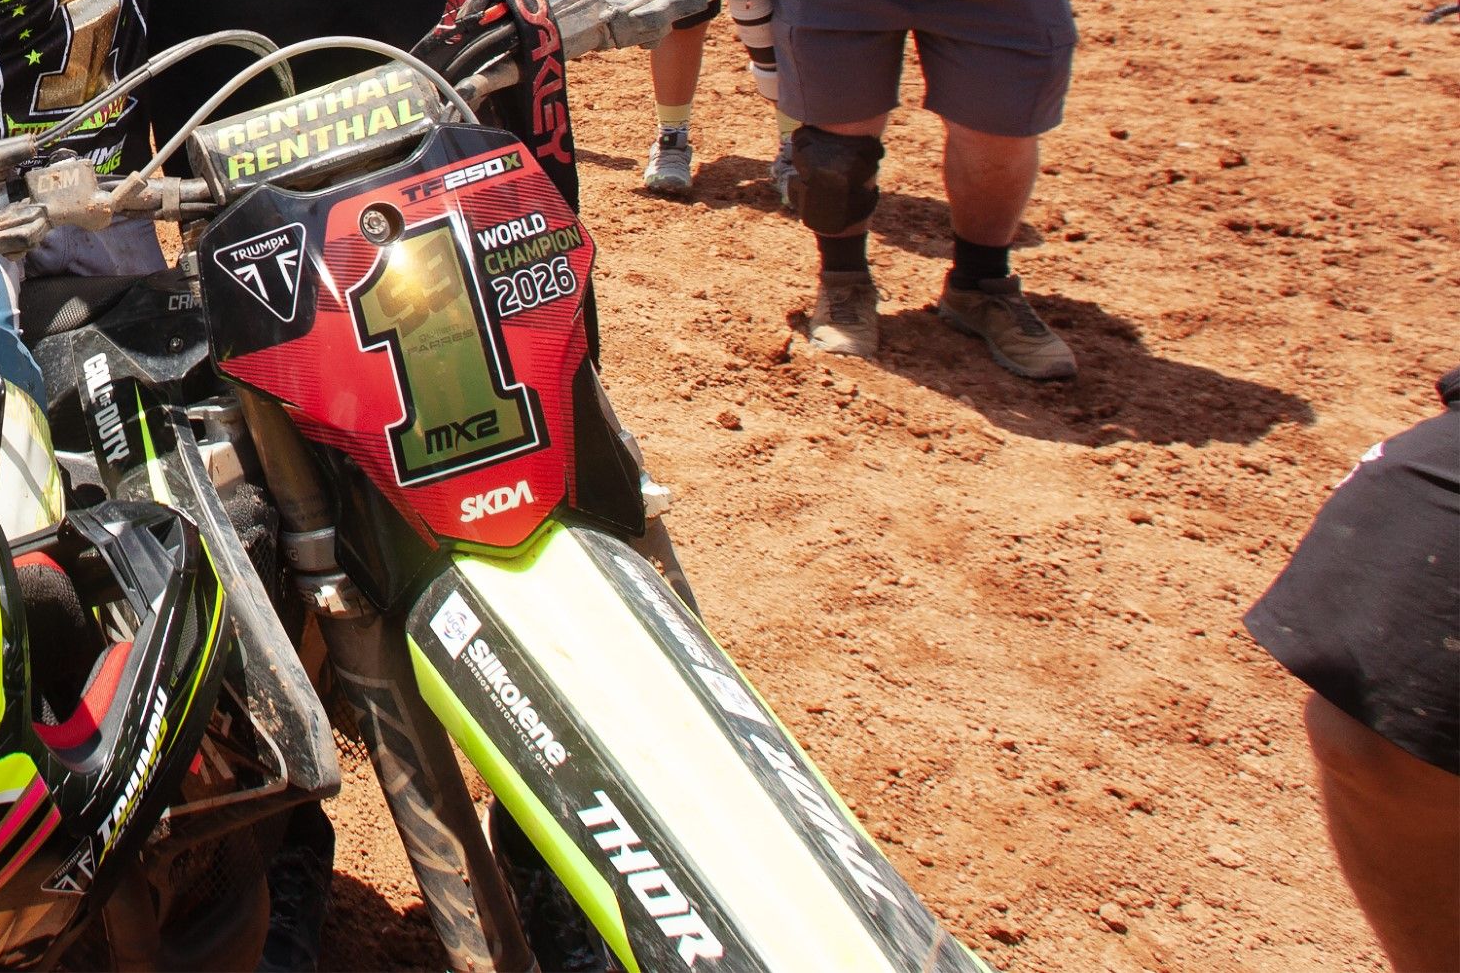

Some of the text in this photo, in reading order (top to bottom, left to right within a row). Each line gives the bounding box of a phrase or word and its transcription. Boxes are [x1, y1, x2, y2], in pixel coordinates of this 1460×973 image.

[217, 71, 413, 151] RENTHAL
[227, 98, 425, 181] RENTHAL
[401, 153, 521, 203] TF250X
[230, 234, 290, 262] TRIUMPH
[477, 213, 546, 251] WORLD
[484, 226, 582, 275] CHAMPION
[491, 256, 576, 317] 2026
[345, 210, 541, 487] 1
[83, 353, 130, 465] CALL OF DUTY
[425, 410, 500, 455] MX2
[460, 480, 535, 523] SKDA
[443, 610, 467, 641] FUCHS
[460, 652, 554, 776] SUPERIOR MOTORCYCLE OILS
[467, 638, 567, 768] Silkolene
[576, 789, 725, 969] THOR
